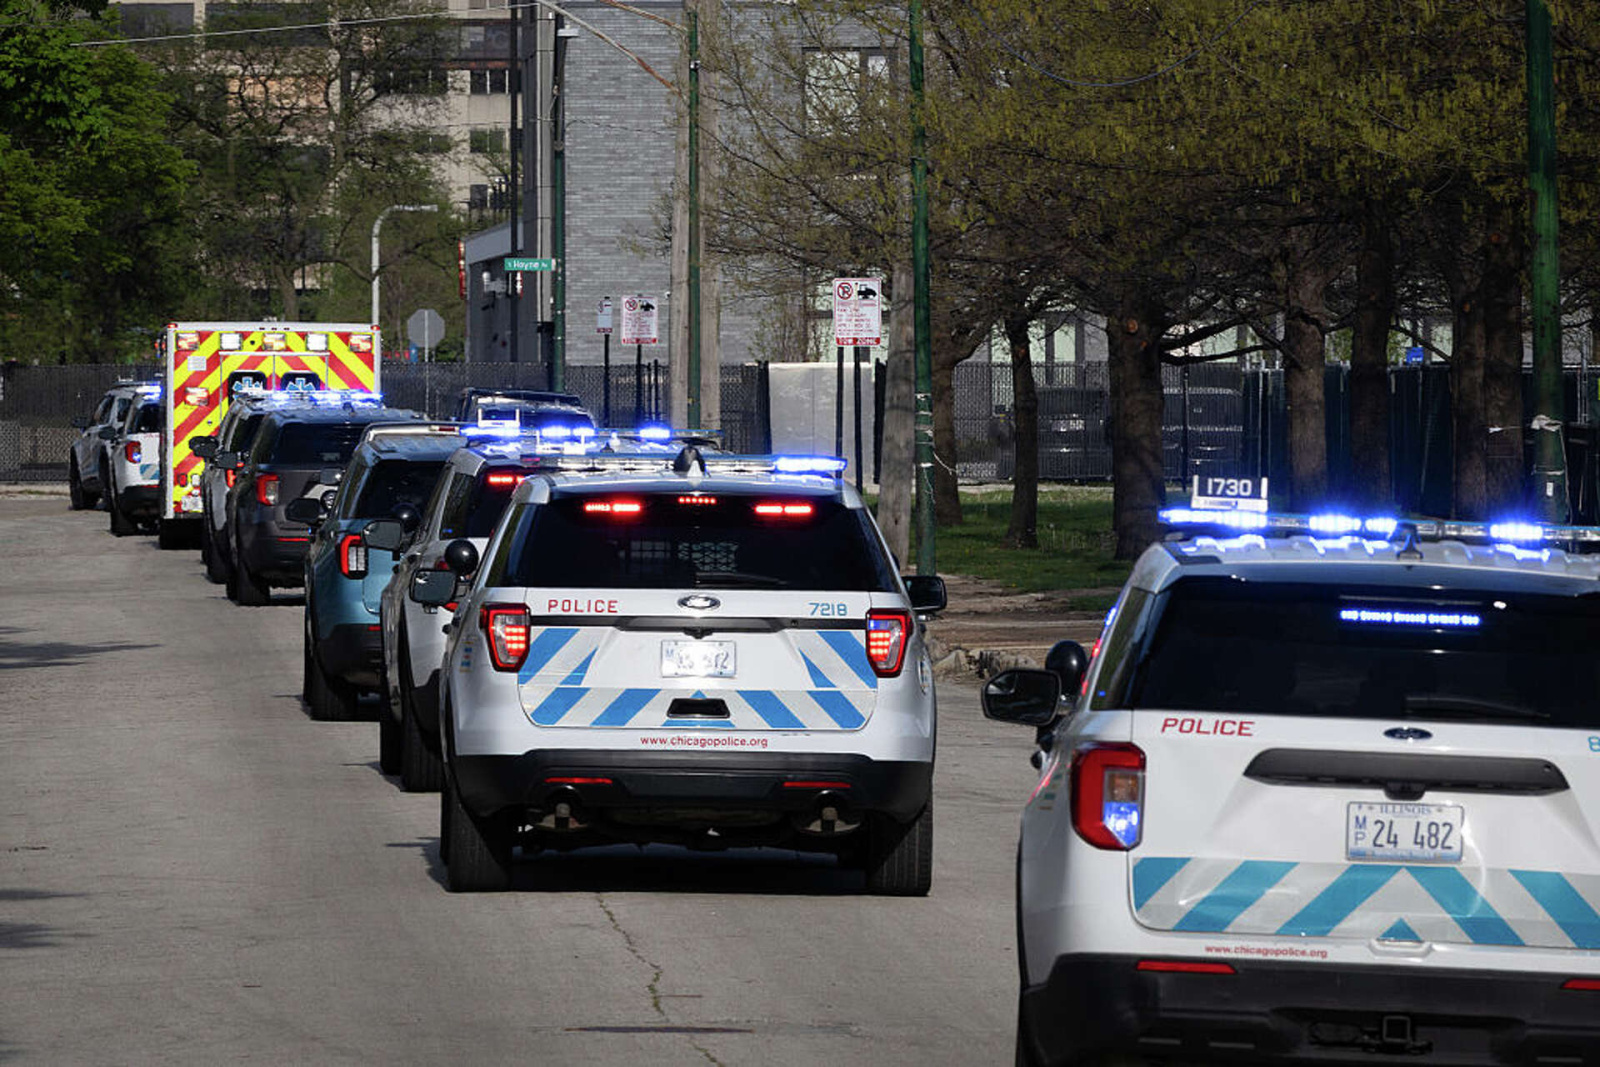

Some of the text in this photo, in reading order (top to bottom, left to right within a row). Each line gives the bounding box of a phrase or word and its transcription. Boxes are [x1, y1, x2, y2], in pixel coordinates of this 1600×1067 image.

[1207, 477, 1252, 496] 1730
[547, 599, 619, 613] POLICE
[809, 602, 848, 616] 7218
[1161, 717, 1255, 736] POLICE
[640, 736, 768, 748] www.chicagopolice.org
[1372, 819, 1453, 850] 24 482
[1205, 945, 1328, 958] www.chicagopolice.org
